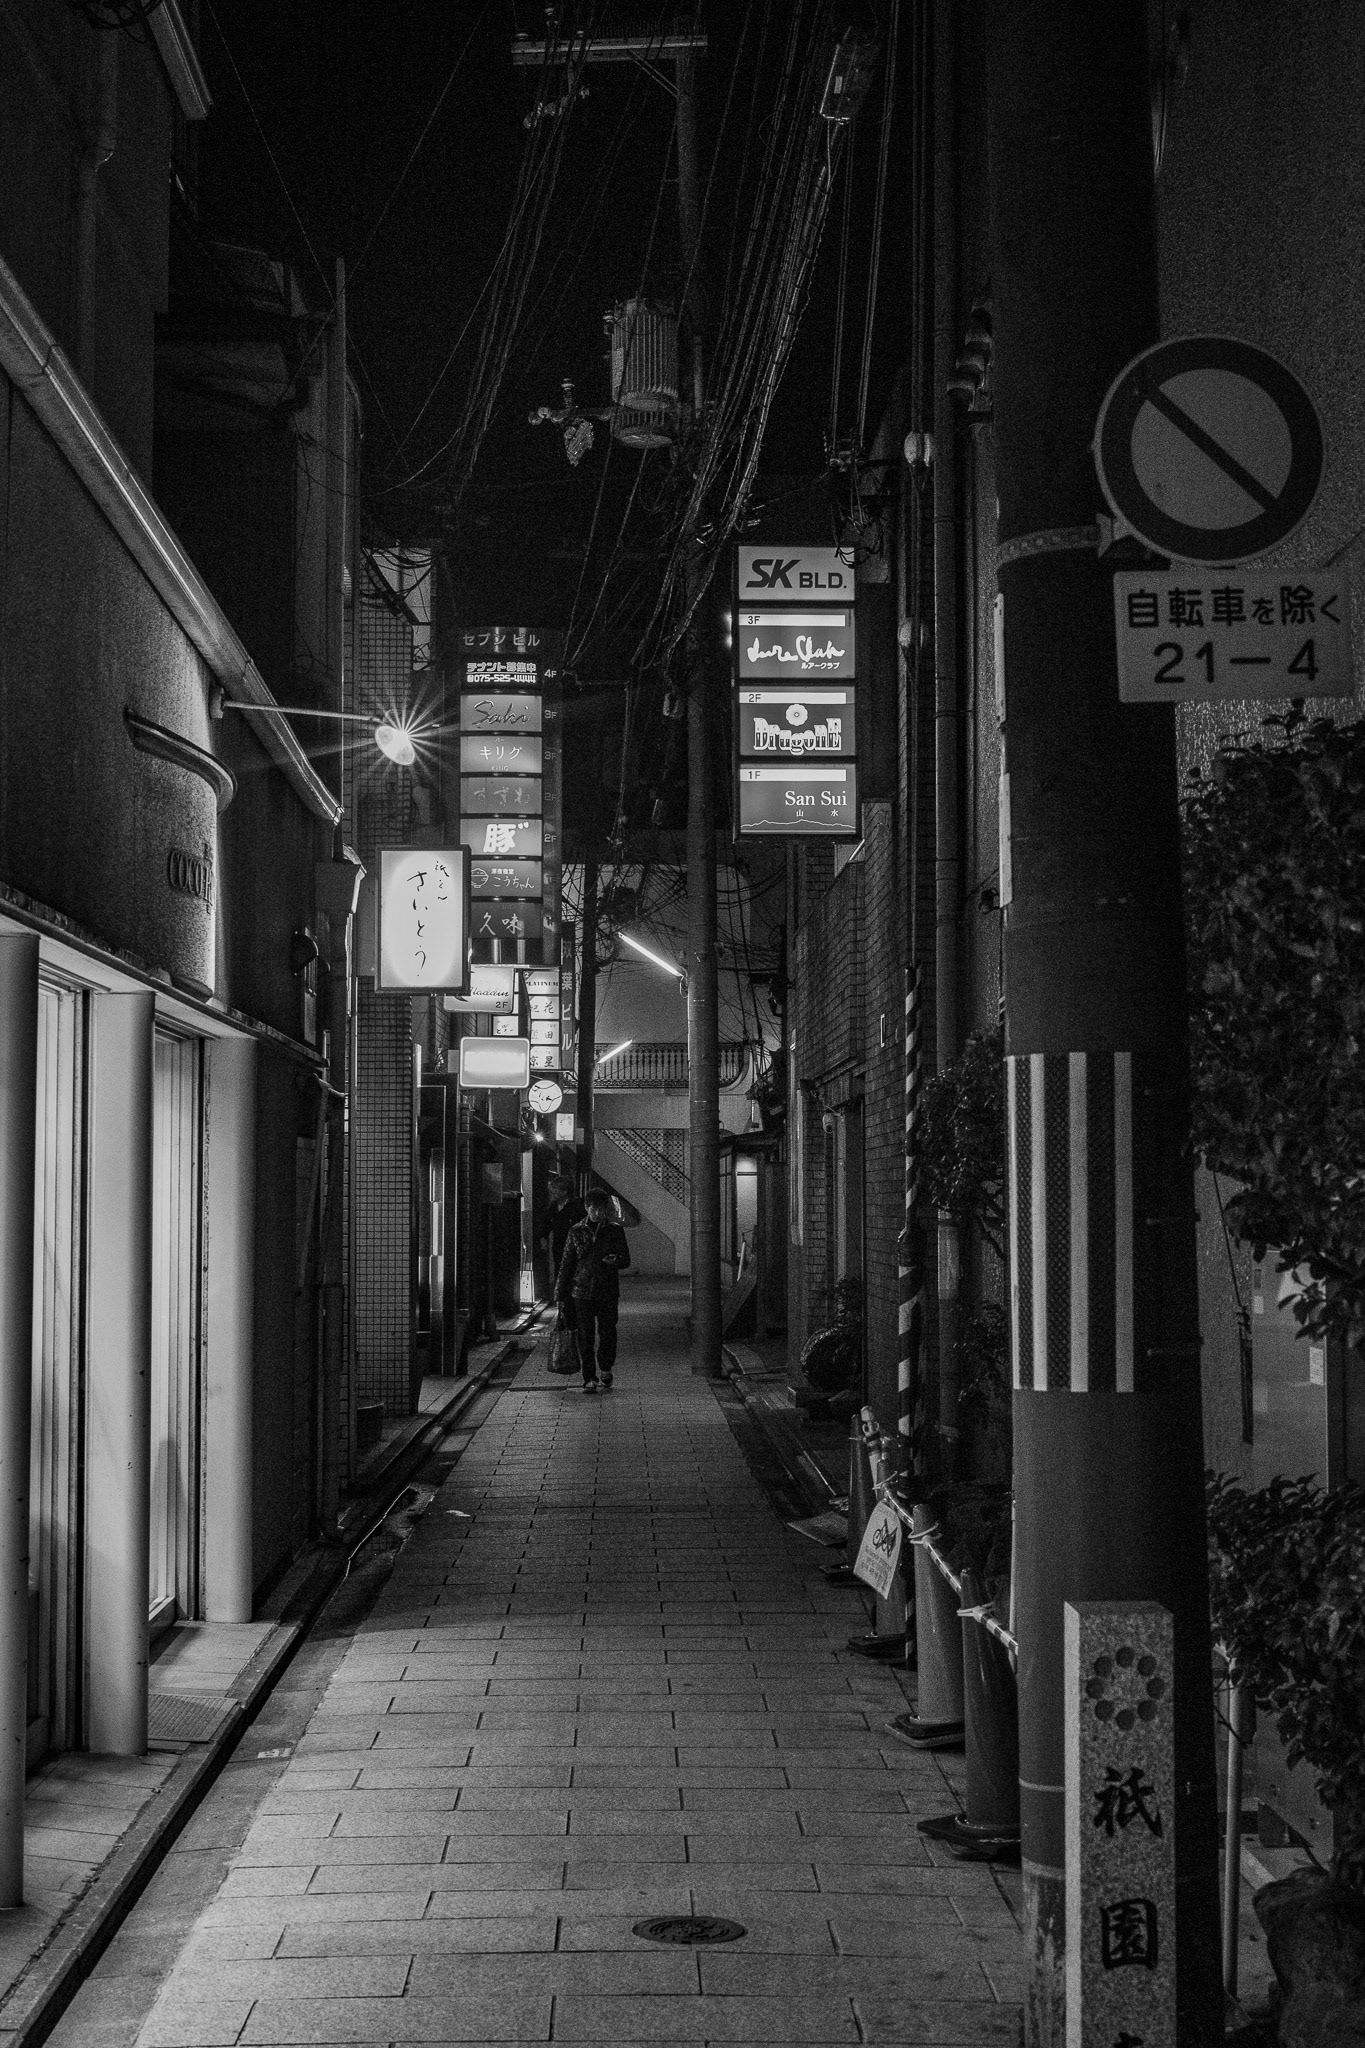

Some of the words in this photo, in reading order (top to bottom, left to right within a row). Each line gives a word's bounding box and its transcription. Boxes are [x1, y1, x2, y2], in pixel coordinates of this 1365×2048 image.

[745, 559, 801, 589] SK
[799, 572, 848, 589] BLD.
[1127, 585, 1342, 629] 自転車を除く
[747, 615, 761, 625] 3F
[466, 661, 537, 672] テナント募集中
[801, 662, 841, 670] ルアークラブ
[544, 669, 557, 678] 4F
[748, 694, 762, 703] 2F
[544, 710, 557, 719] 3F
[480, 746, 523, 760] キリグ
[748, 771, 762, 780] 1F
[785, 790, 816, 806] San
[820, 790, 848, 806] Sui
[544, 833, 557, 843] 2F
[493, 876, 535, 889] こうちゃん
[495, 1001, 509, 1009] 2F
[1093, 1765, 1163, 2048] 祇園
